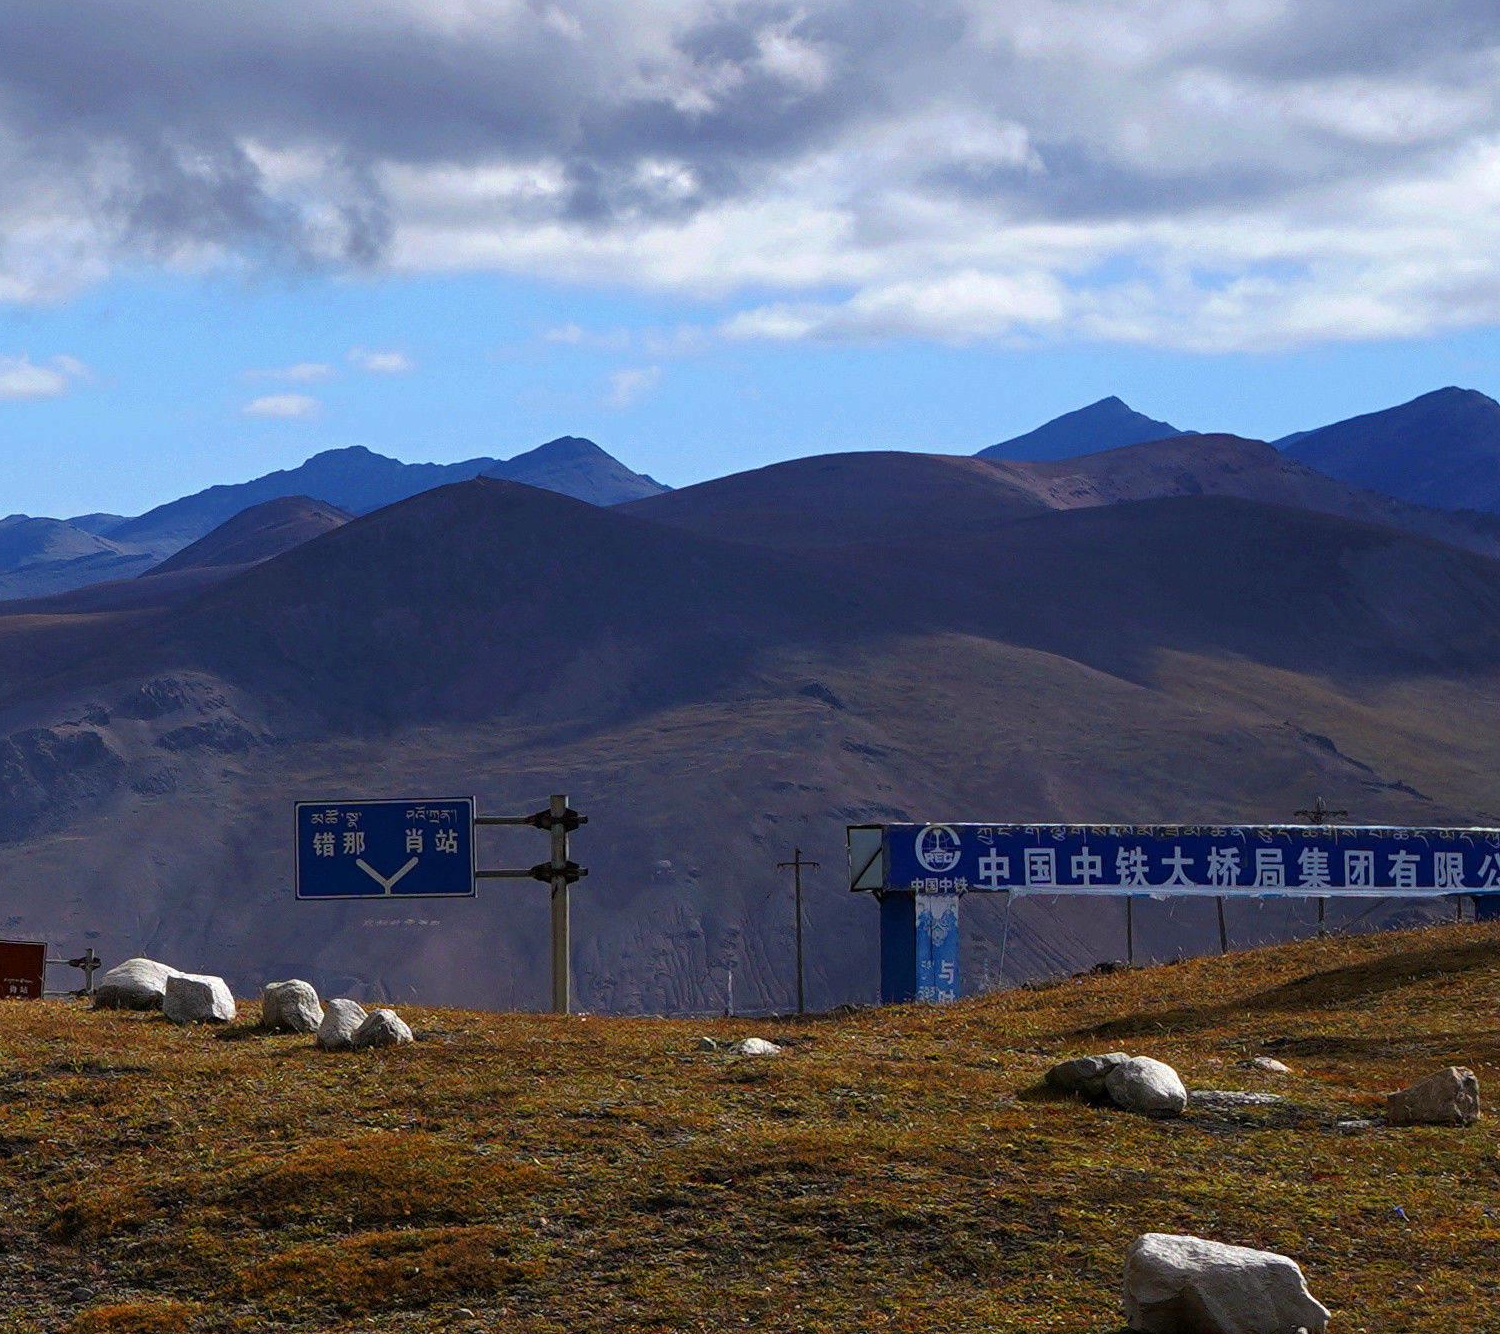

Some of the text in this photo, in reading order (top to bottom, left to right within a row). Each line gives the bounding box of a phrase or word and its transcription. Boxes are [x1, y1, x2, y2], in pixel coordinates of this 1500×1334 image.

[312, 831, 366, 857] 错那
[405, 827, 458, 854] 肖站
[978, 845, 1500, 890] 中国中铁大桥局集团有限公
[911, 876, 969, 894] 中国中铁
